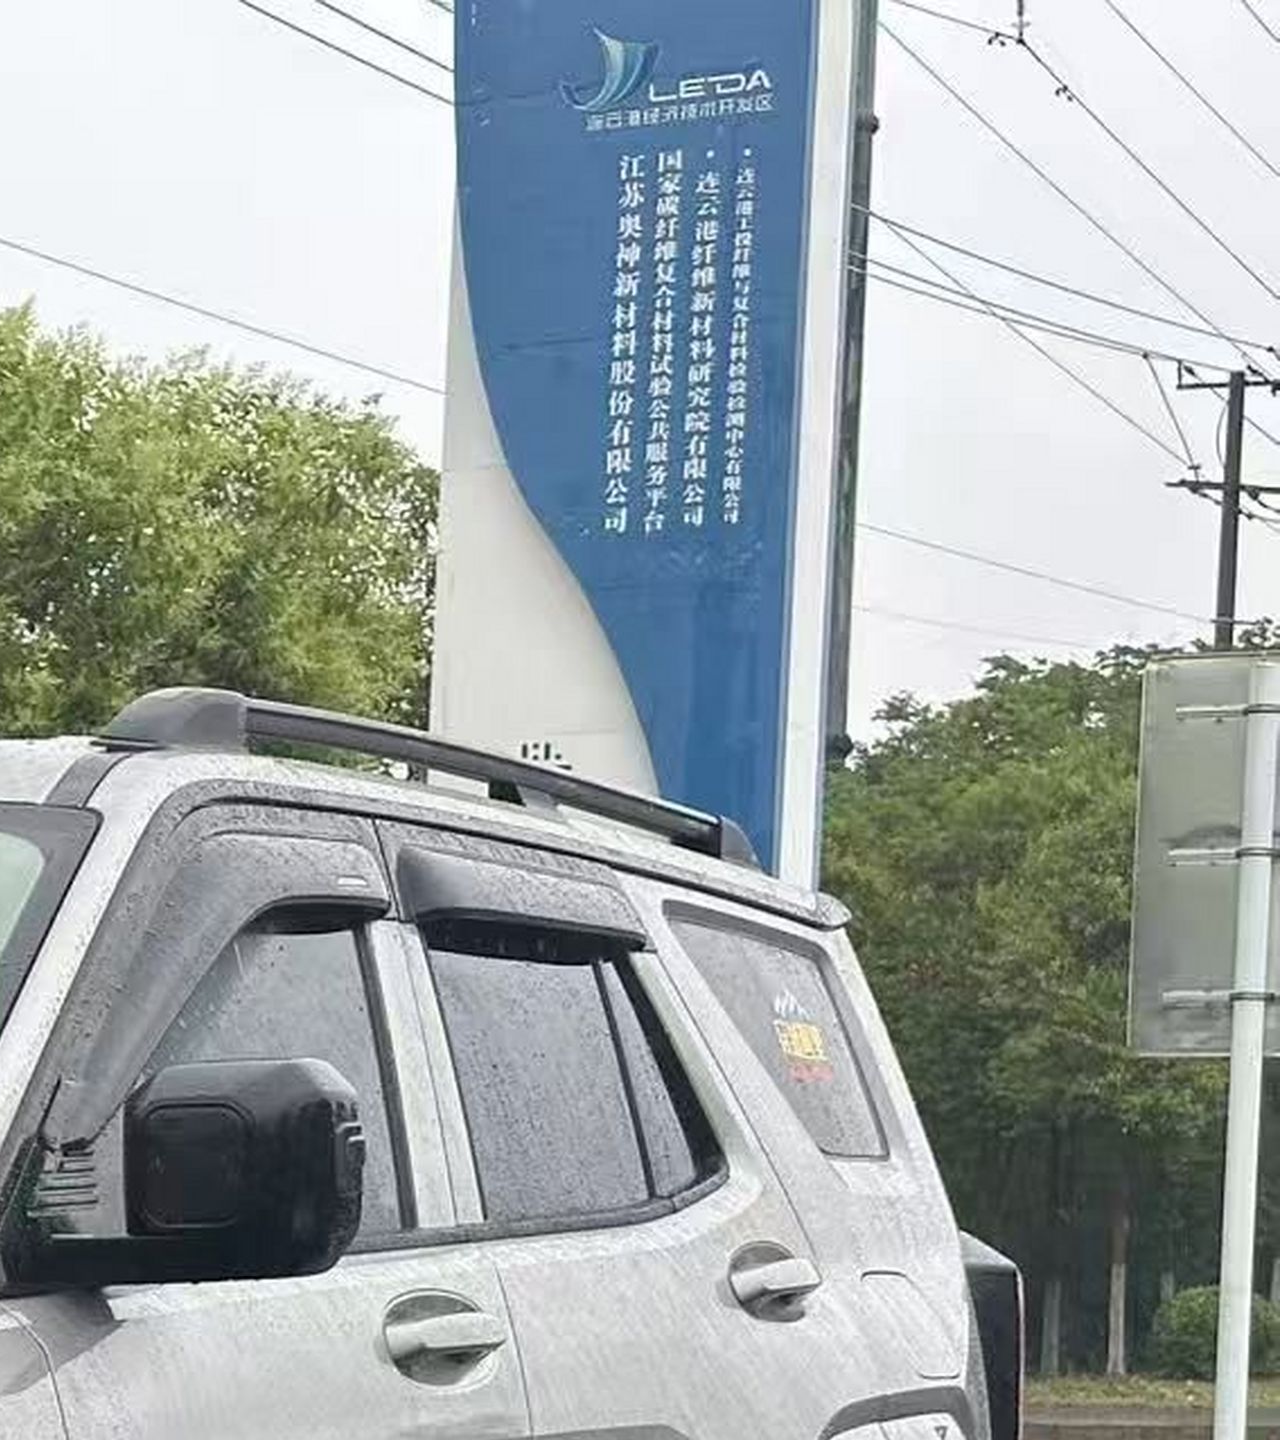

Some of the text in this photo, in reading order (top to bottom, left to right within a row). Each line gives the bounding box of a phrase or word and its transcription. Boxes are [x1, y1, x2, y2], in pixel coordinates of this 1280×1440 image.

[649, 69, 771, 102] LEDA
[604, 154, 645, 533] 江苏奥神新材料股份有限公司
[643, 149, 682, 534] 国家碳纤维复合材料试验公共服务平台
[683, 171, 720, 526] 连云港纤维新材料研究院有限公司
